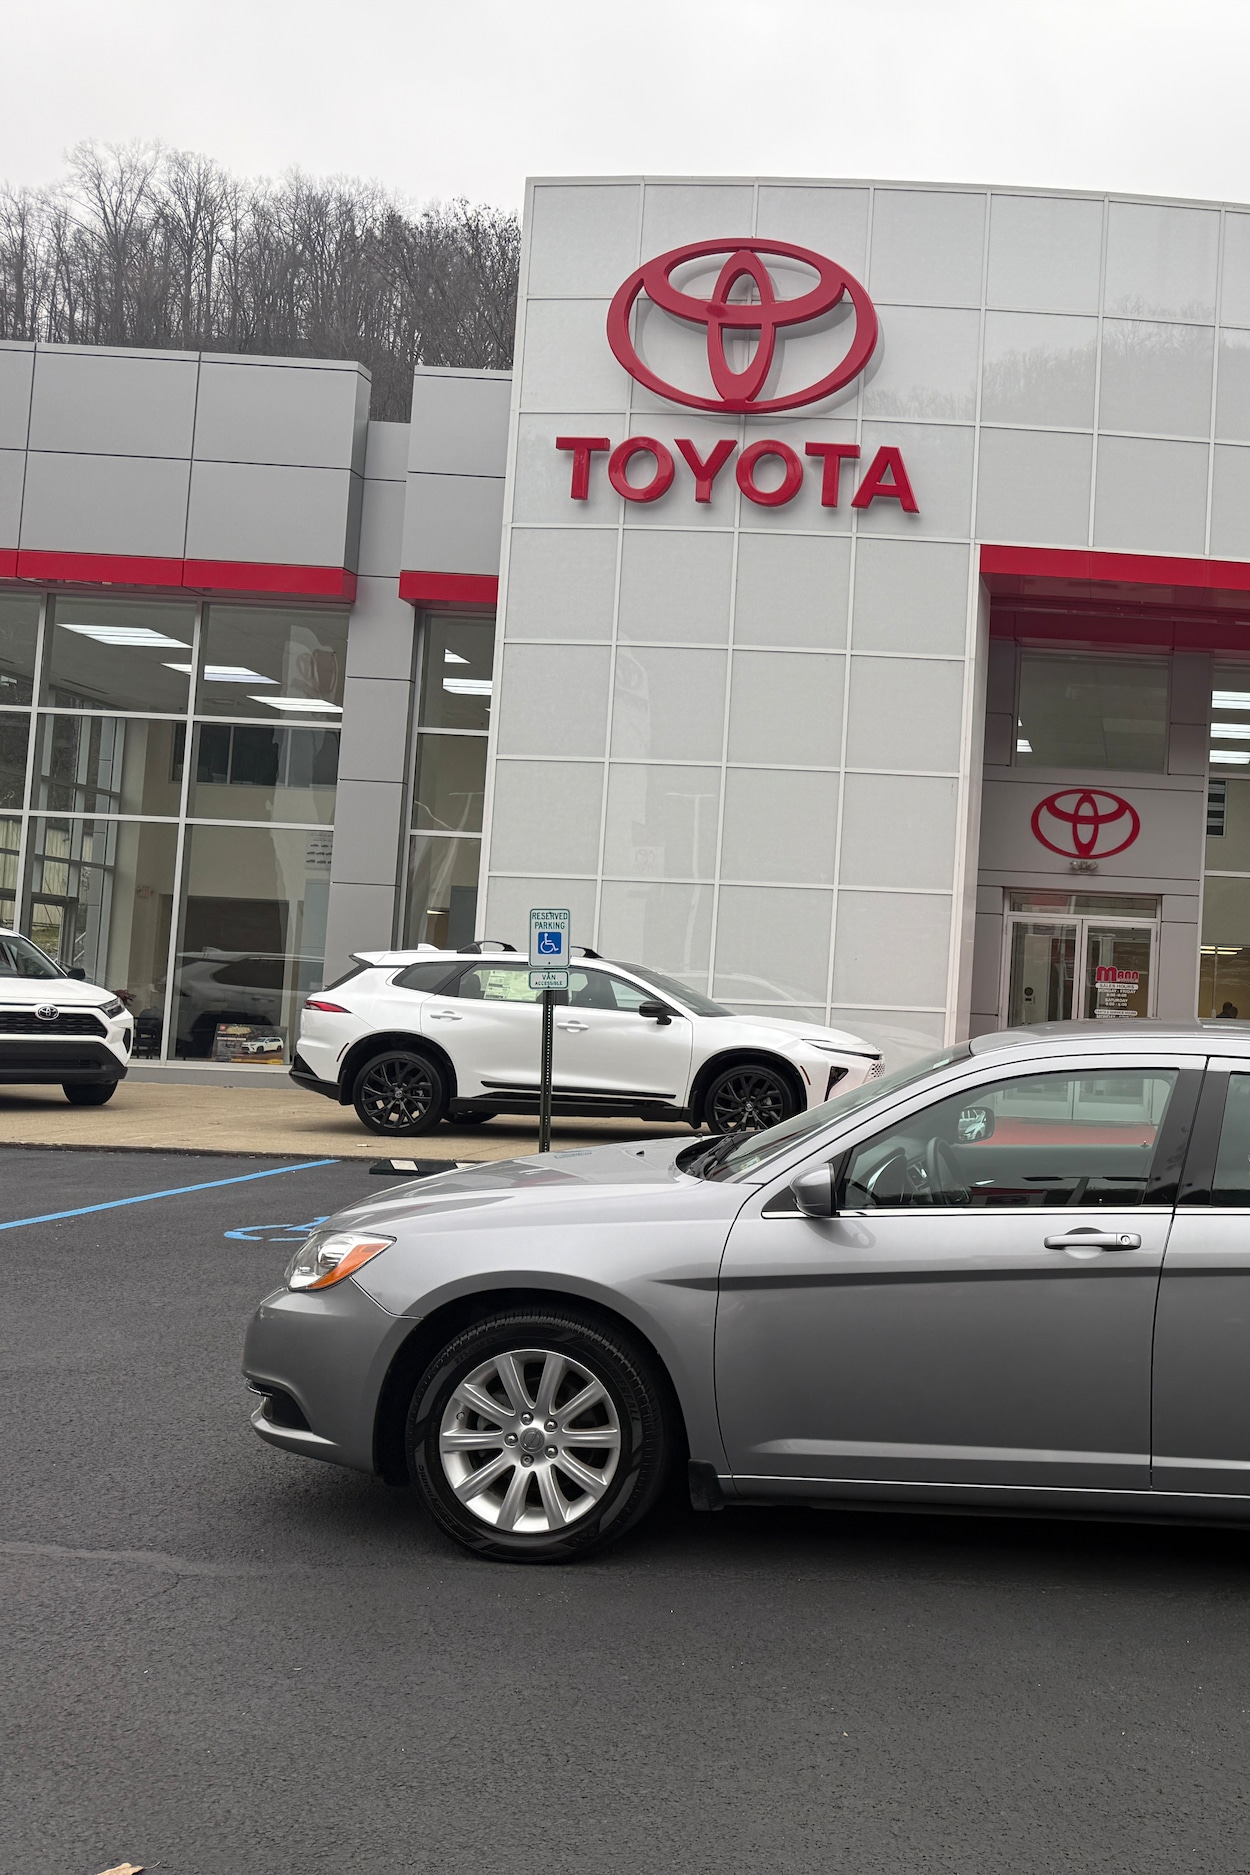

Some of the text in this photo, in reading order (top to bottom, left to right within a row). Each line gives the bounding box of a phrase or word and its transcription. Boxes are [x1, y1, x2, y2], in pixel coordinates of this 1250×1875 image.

[555, 436, 921, 514] TOYOTA
[532, 912, 568, 920] RESERVED
[534, 922, 565, 930] PARKING
